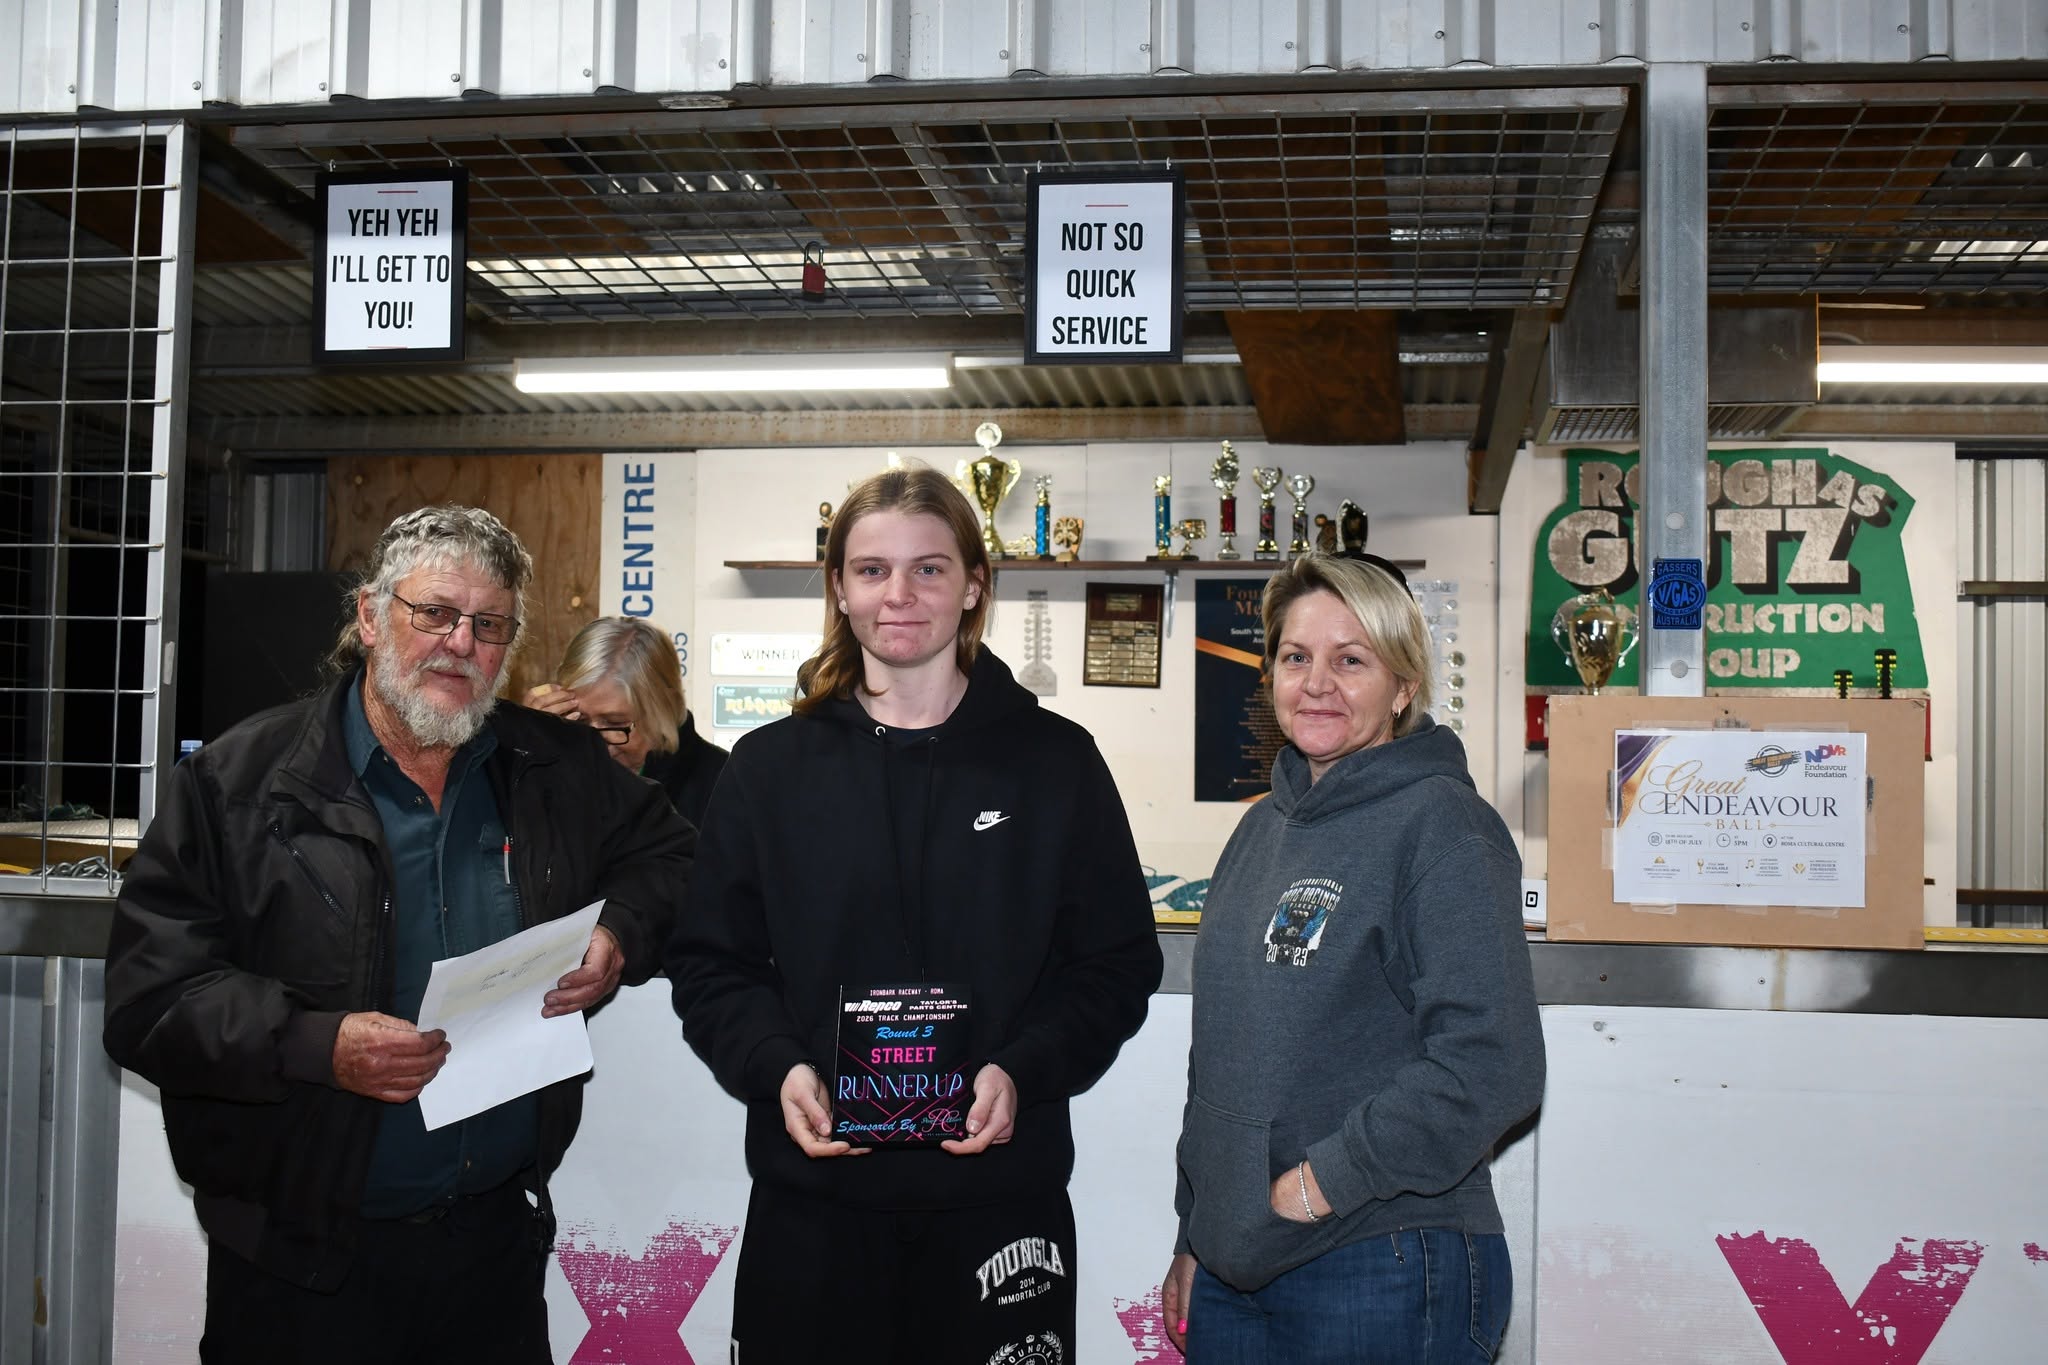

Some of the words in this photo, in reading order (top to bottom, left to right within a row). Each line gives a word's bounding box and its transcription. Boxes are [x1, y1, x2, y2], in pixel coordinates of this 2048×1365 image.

[348, 208, 389, 236] YEH
[397, 208, 438, 236] YEH
[1061, 222, 1107, 251] NOT
[1114, 222, 1143, 251] SO
[332, 255, 369, 282] I'LL
[377, 255, 417, 282] GET
[423, 255, 450, 282] TO
[1066, 269, 1136, 300] QUICK
[364, 301, 413, 329] YOU!
[1052, 316, 1148, 345] SERVICE
[1578, 459, 1816, 507] RGH
[1817, 469, 1887, 517] AS
[621, 463, 655, 617] CENTRE
[1548, 508, 1850, 586] GTZ
[1657, 563, 1697, 575] GASSERS
[1659, 581, 1697, 607] V/GAS
[1656, 614, 1698, 625] AUSTRALIA
[1709, 648, 1800, 678] OUP
[1648, 760, 1747, 799] Great
[979, 810, 1002, 823] NIKE
[1660, 793, 1838, 817] ENDEAVOUR
[1716, 819, 1765, 831] BALL
[1266, 943, 1278, 962] 20
[1293, 946, 1308, 967] 23
[858, 1000, 902, 1013] Repco
[903, 1013, 955, 1021] CHAMPIONSHIP
[876, 1026, 919, 1039] Round
[922, 1025, 934, 1037] 3
[871, 1047, 936, 1064] STREET
[838, 1073, 929, 1100] RUNNER
[935, 1073, 963, 1097] UP
[836, 1120, 897, 1133] Sponsored
[900, 1119, 917, 1132] By
[976, 1237, 1066, 1301] YOUNGLA
[998, 1288, 1036, 1305] IMMORTAL
[1037, 1281, 1051, 1294] CLUB
[1020, 1276, 1035, 1289] 2014
[1001, 1343, 1053, 1365] OUNGLA
